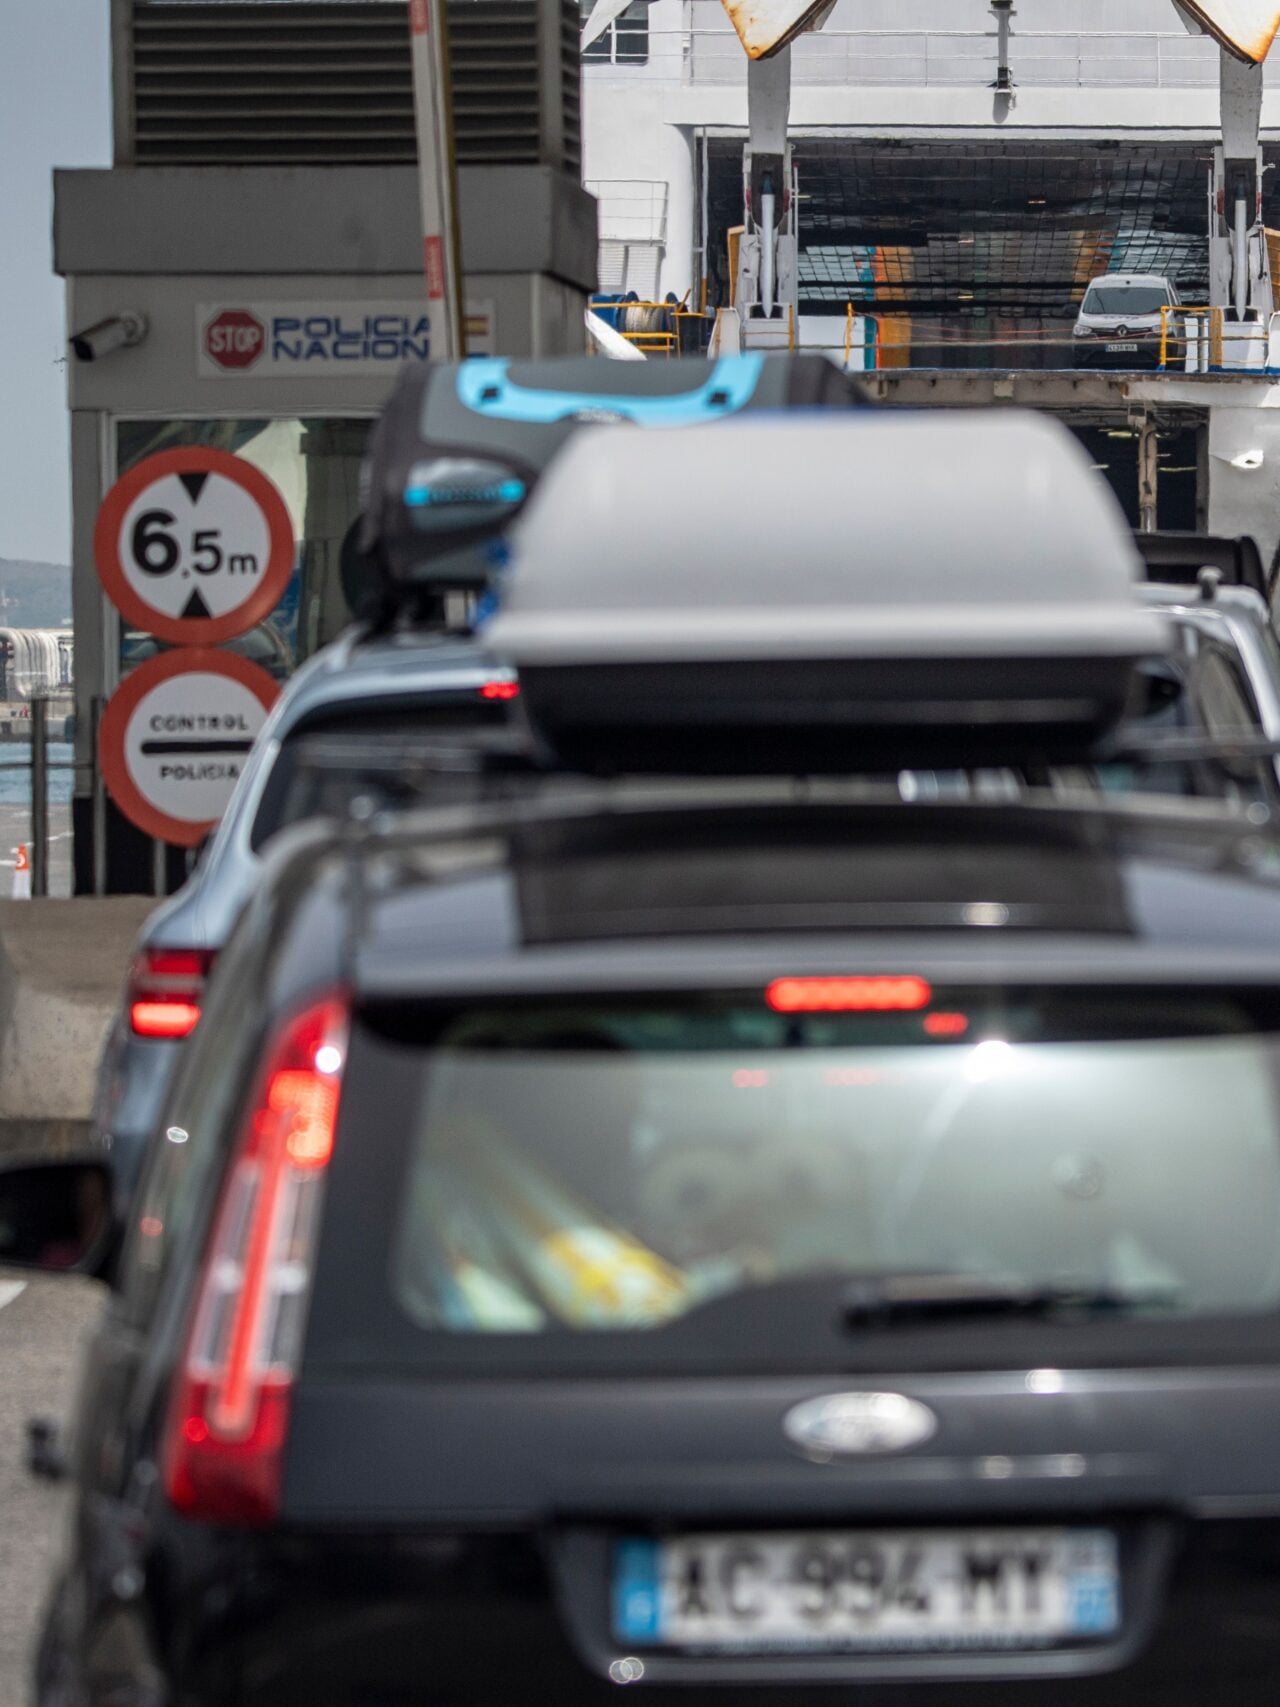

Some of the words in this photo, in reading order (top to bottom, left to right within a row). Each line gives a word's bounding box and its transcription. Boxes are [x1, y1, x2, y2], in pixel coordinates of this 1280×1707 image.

[209, 325, 261, 353] STOP
[272, 315, 431, 339] POLICIA
[150, 713, 249, 732] CONTROL
